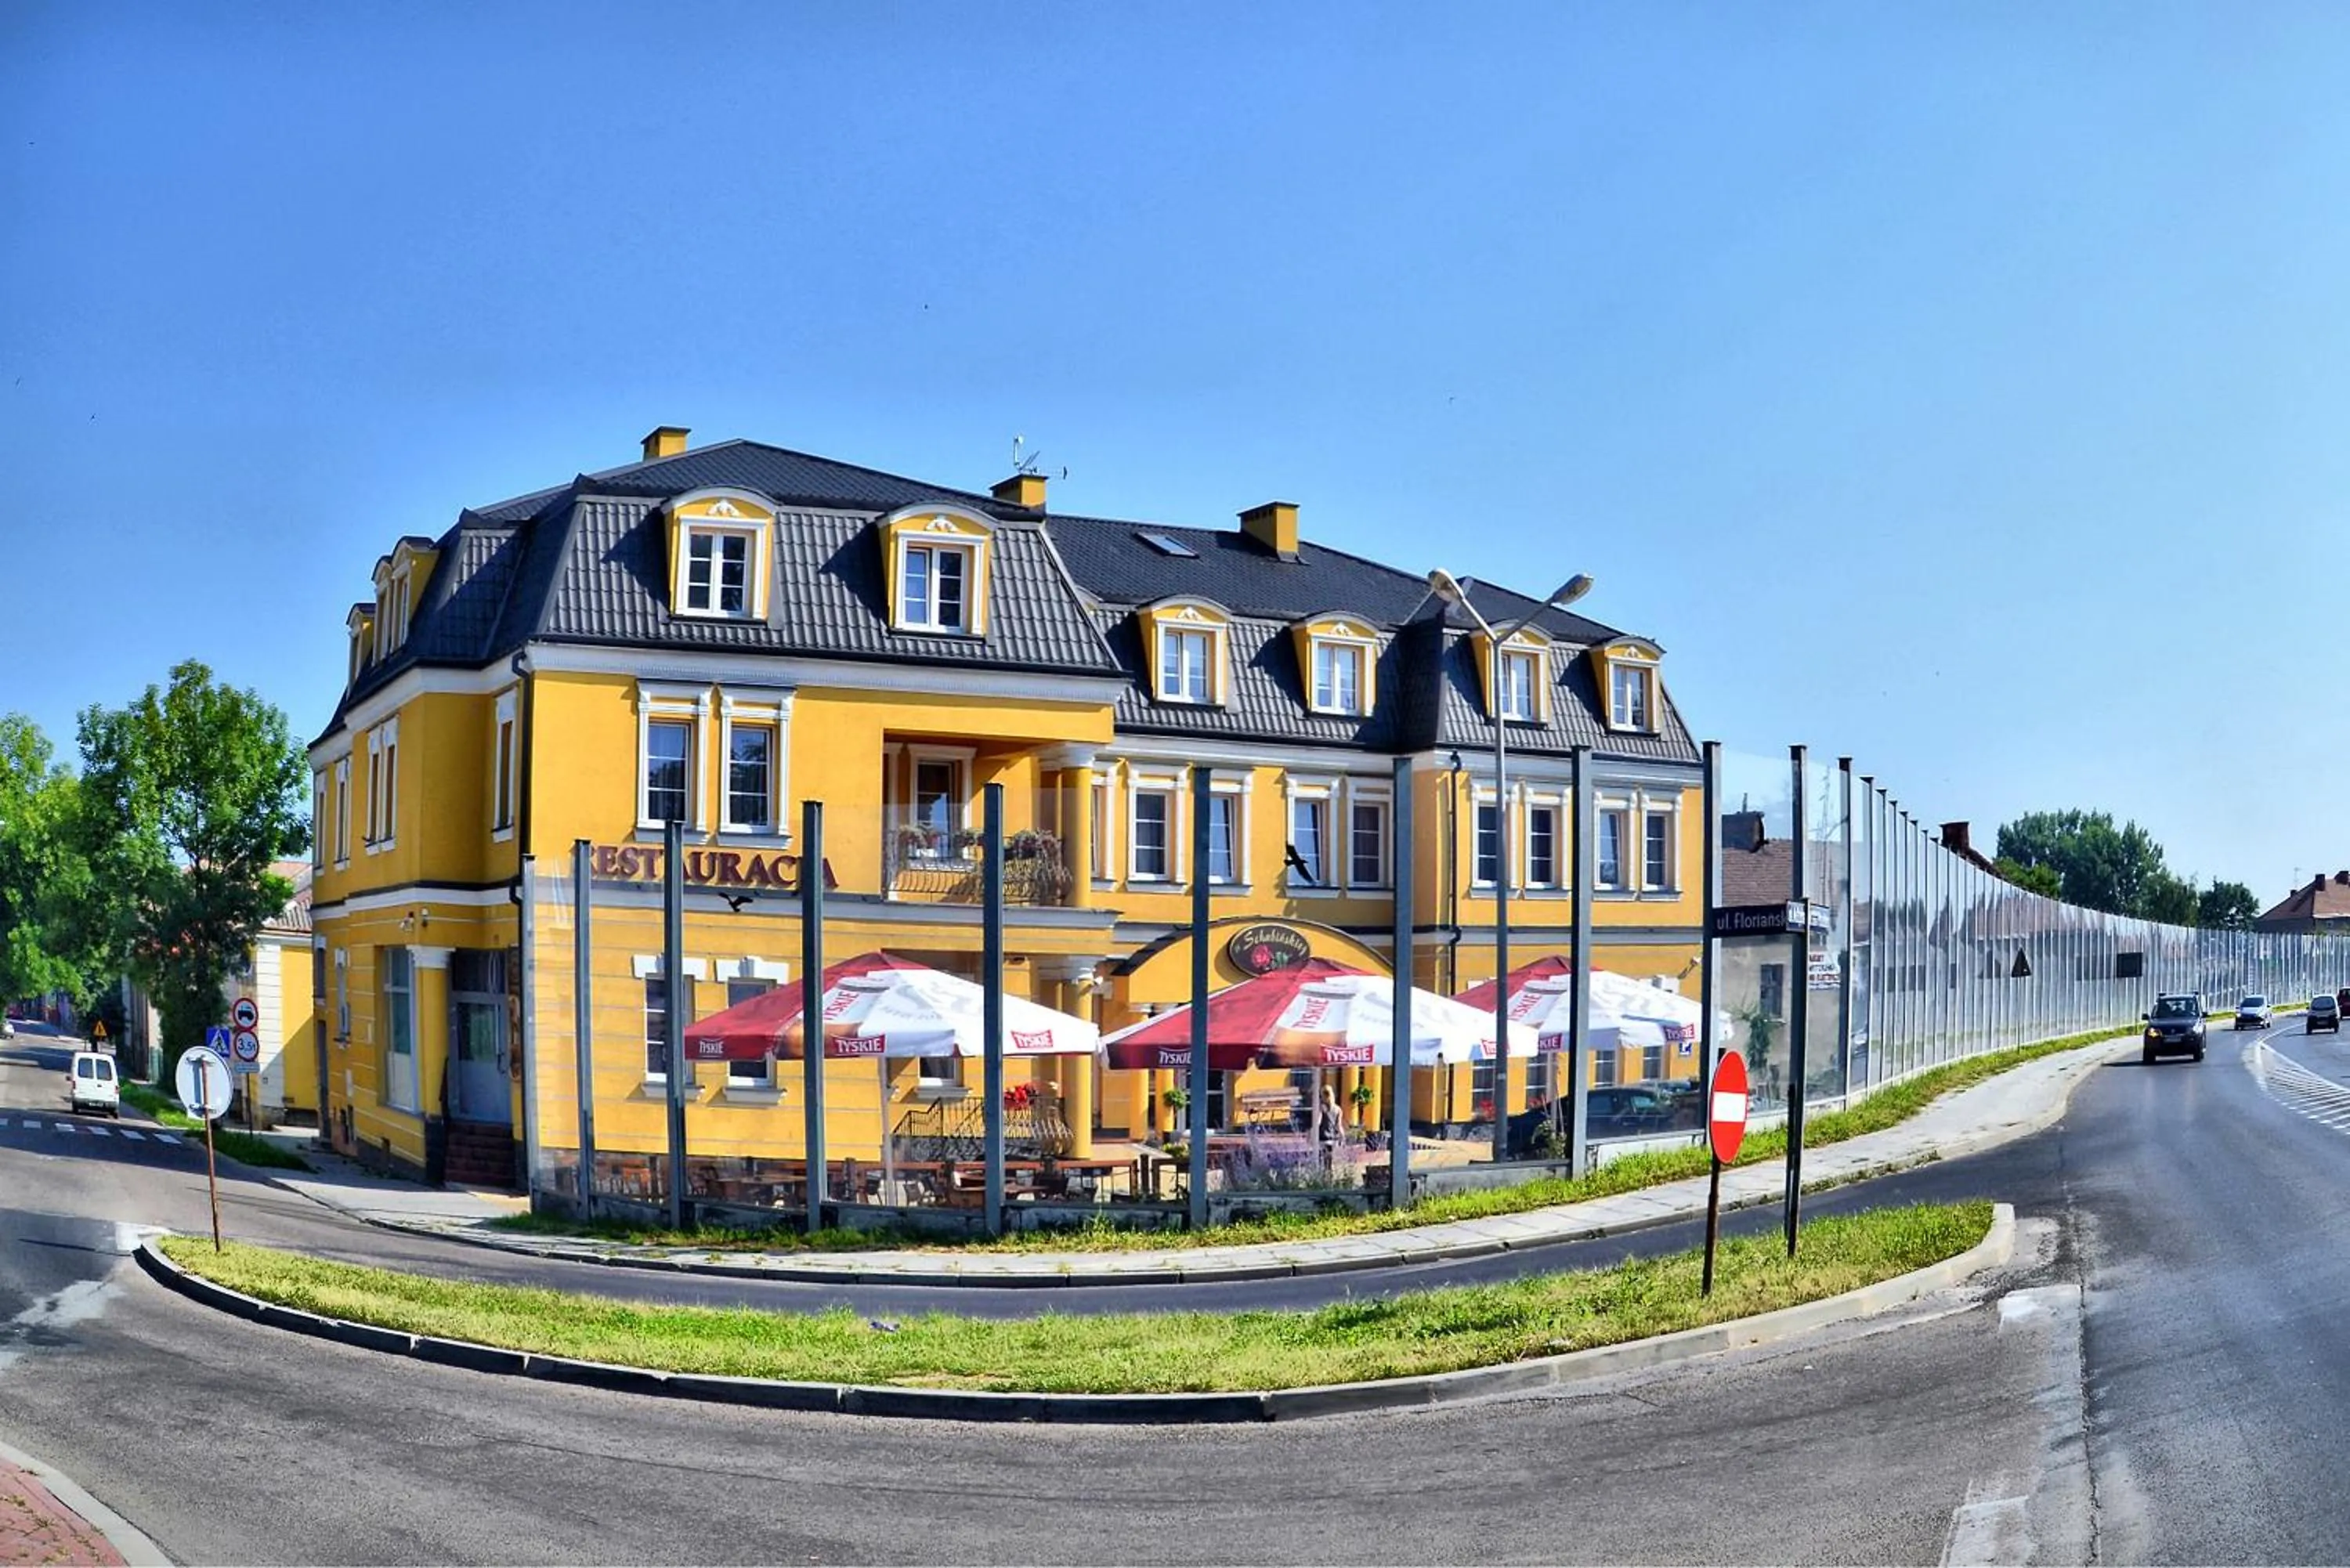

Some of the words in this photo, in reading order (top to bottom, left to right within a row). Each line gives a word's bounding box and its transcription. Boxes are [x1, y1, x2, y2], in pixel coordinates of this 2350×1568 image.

[573, 845, 839, 889] ESTURACA
[1716, 912, 1732, 930] ul.
[1734, 909, 1788, 930] Floriańsk
[1291, 997, 1329, 1028] TYSKIE
[700, 1041, 724, 1054] TYSKIE
[835, 1037, 883, 1053] TYSKIE
[1016, 1031, 1053, 1048] TYSKIE
[1159, 1050, 1192, 1064] TYSKIE
[1324, 1047, 1371, 1062] TYSKIE
